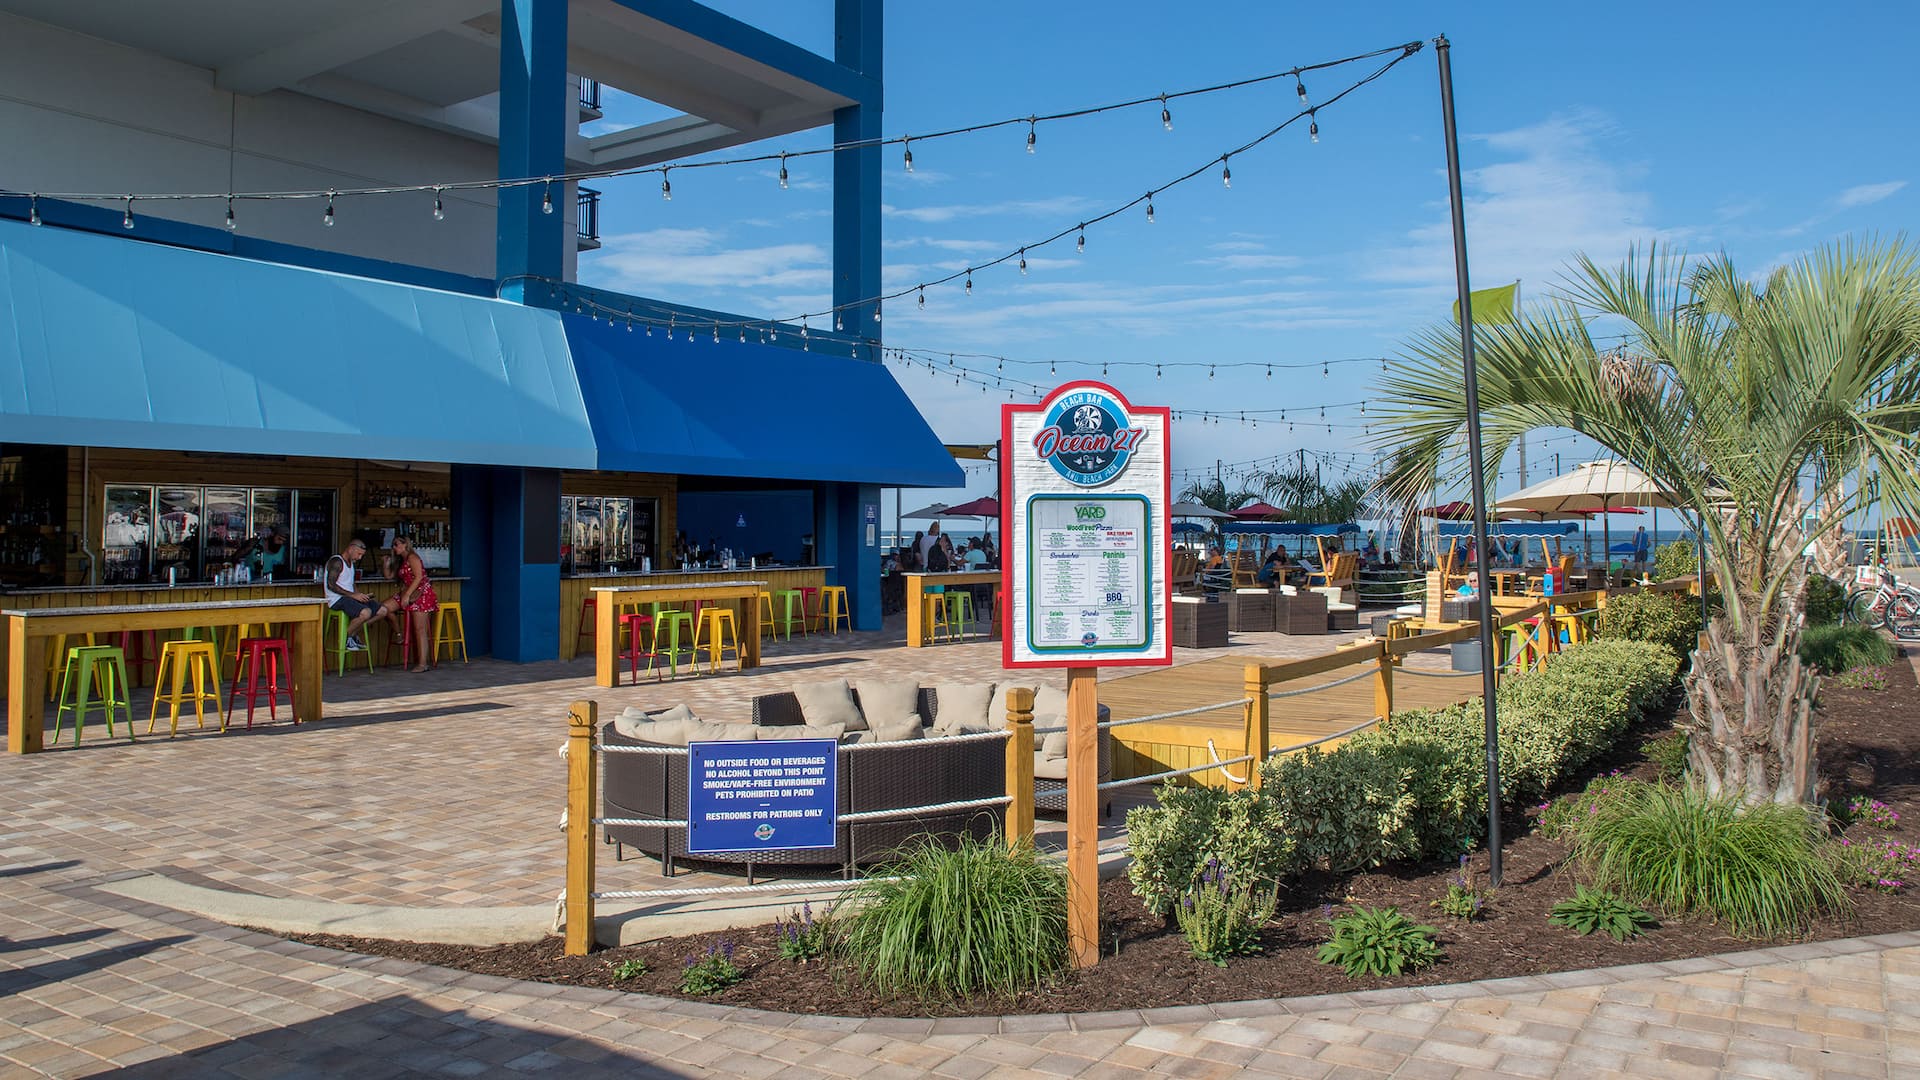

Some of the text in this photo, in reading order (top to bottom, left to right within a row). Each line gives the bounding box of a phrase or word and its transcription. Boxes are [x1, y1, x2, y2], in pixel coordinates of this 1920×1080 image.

[1060, 394, 1103, 410] BEACH BAR
[1033, 427, 1143, 458] Ocean 27
[1065, 464, 1118, 483] AND BEACH PARK
[1074, 506, 1106, 518] YARD
[1103, 551, 1125, 559] Paninis
[1106, 593, 1122, 601] BBQ
[704, 757, 826, 767] NO OUTSIDE FOOD OR BEVERAGES
[706, 767, 824, 778] NO ALCOHOL BEYOND THIS POINT
[703, 778, 826, 789] SMOKE/VAPE-FREE ENVIRONMENT
[715, 788, 814, 799] PETS PROHIBITED ON PATIO
[706, 809, 823, 821] RESTROOMS FOR PATRONS ONLY
